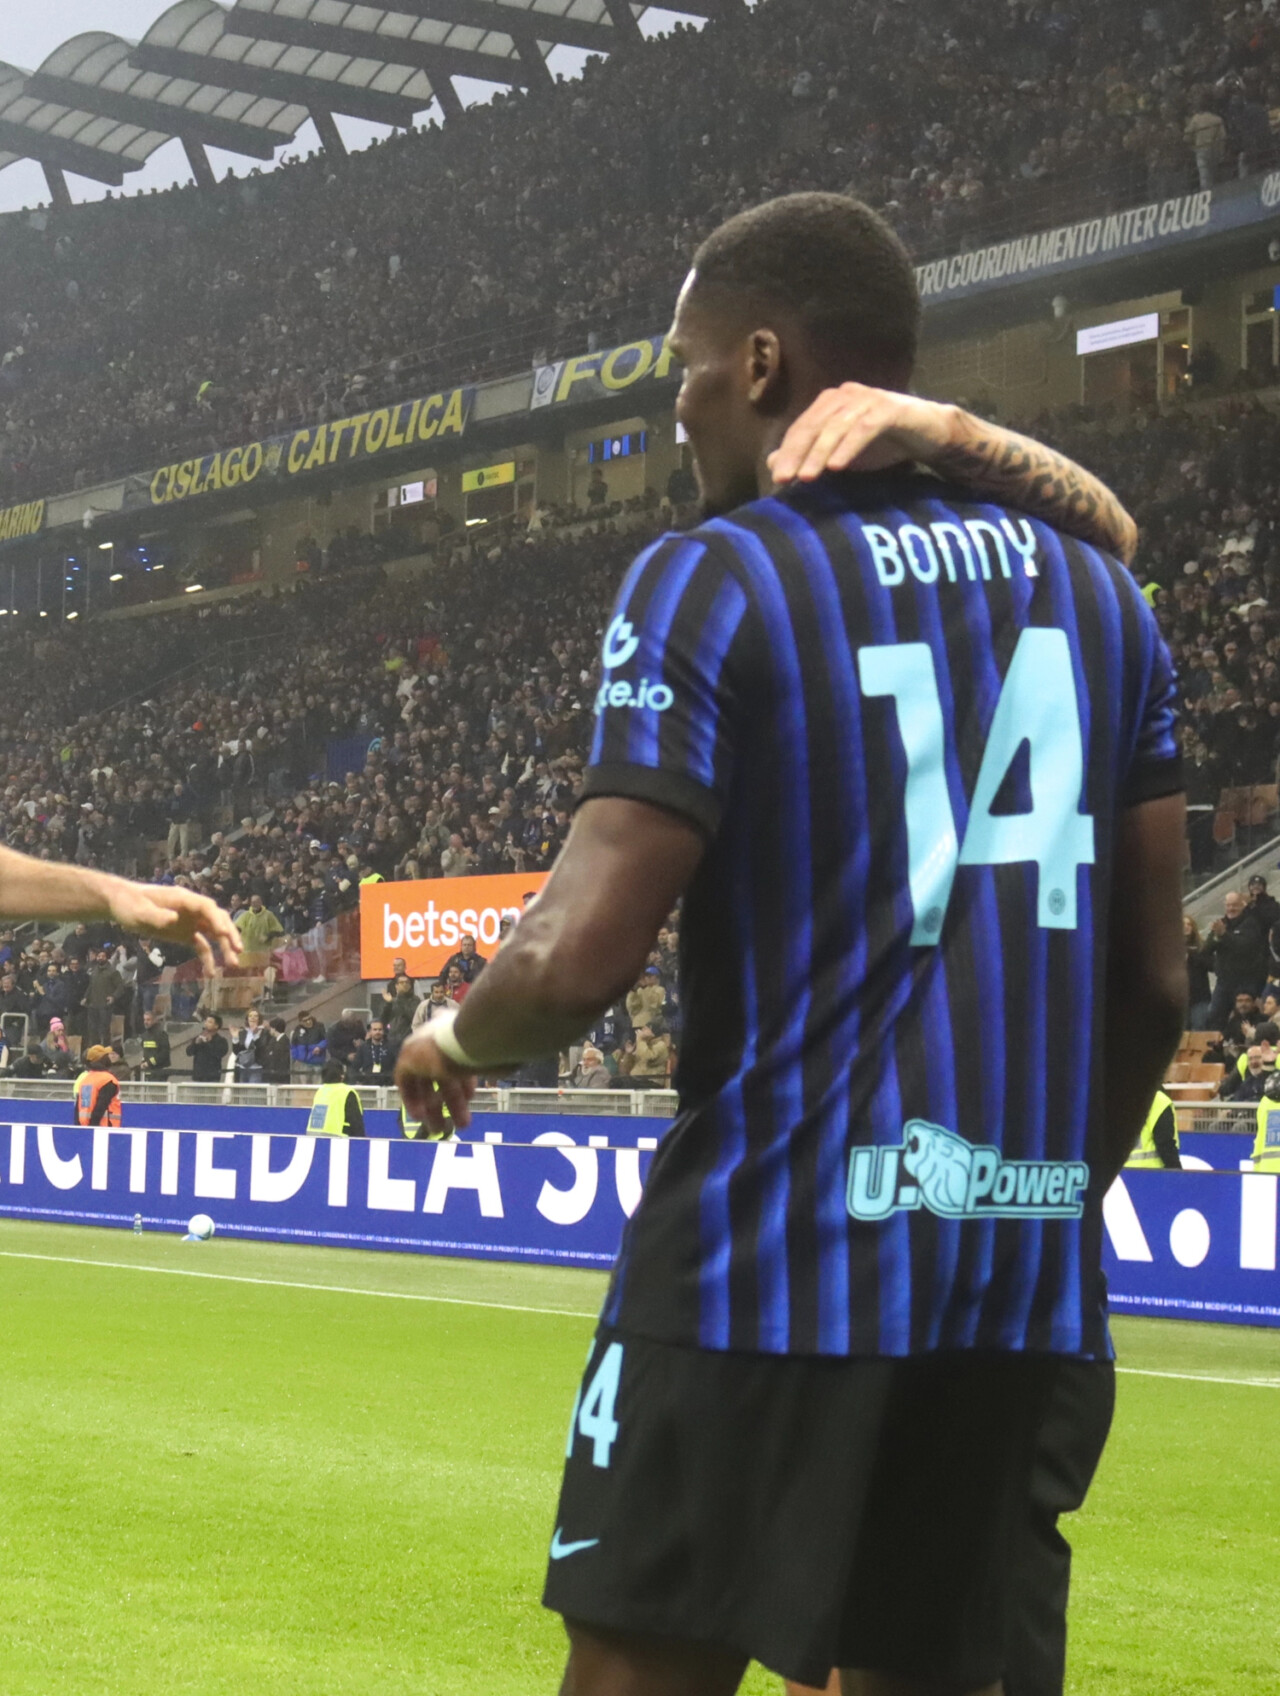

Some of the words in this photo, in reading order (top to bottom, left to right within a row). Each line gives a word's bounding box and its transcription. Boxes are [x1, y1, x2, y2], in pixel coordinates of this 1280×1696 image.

[912, 259, 948, 296] TRO
[947, 219, 1101, 289] COORDINAMENTO
[1101, 204, 1158, 251] INTER
[1158, 190, 1212, 235] CLUB
[150, 442, 263, 505] CISLAGO
[287, 388, 465, 474] CATTOLICA
[861, 518, 1039, 586] BONNY
[858, 627, 1095, 946] 14
